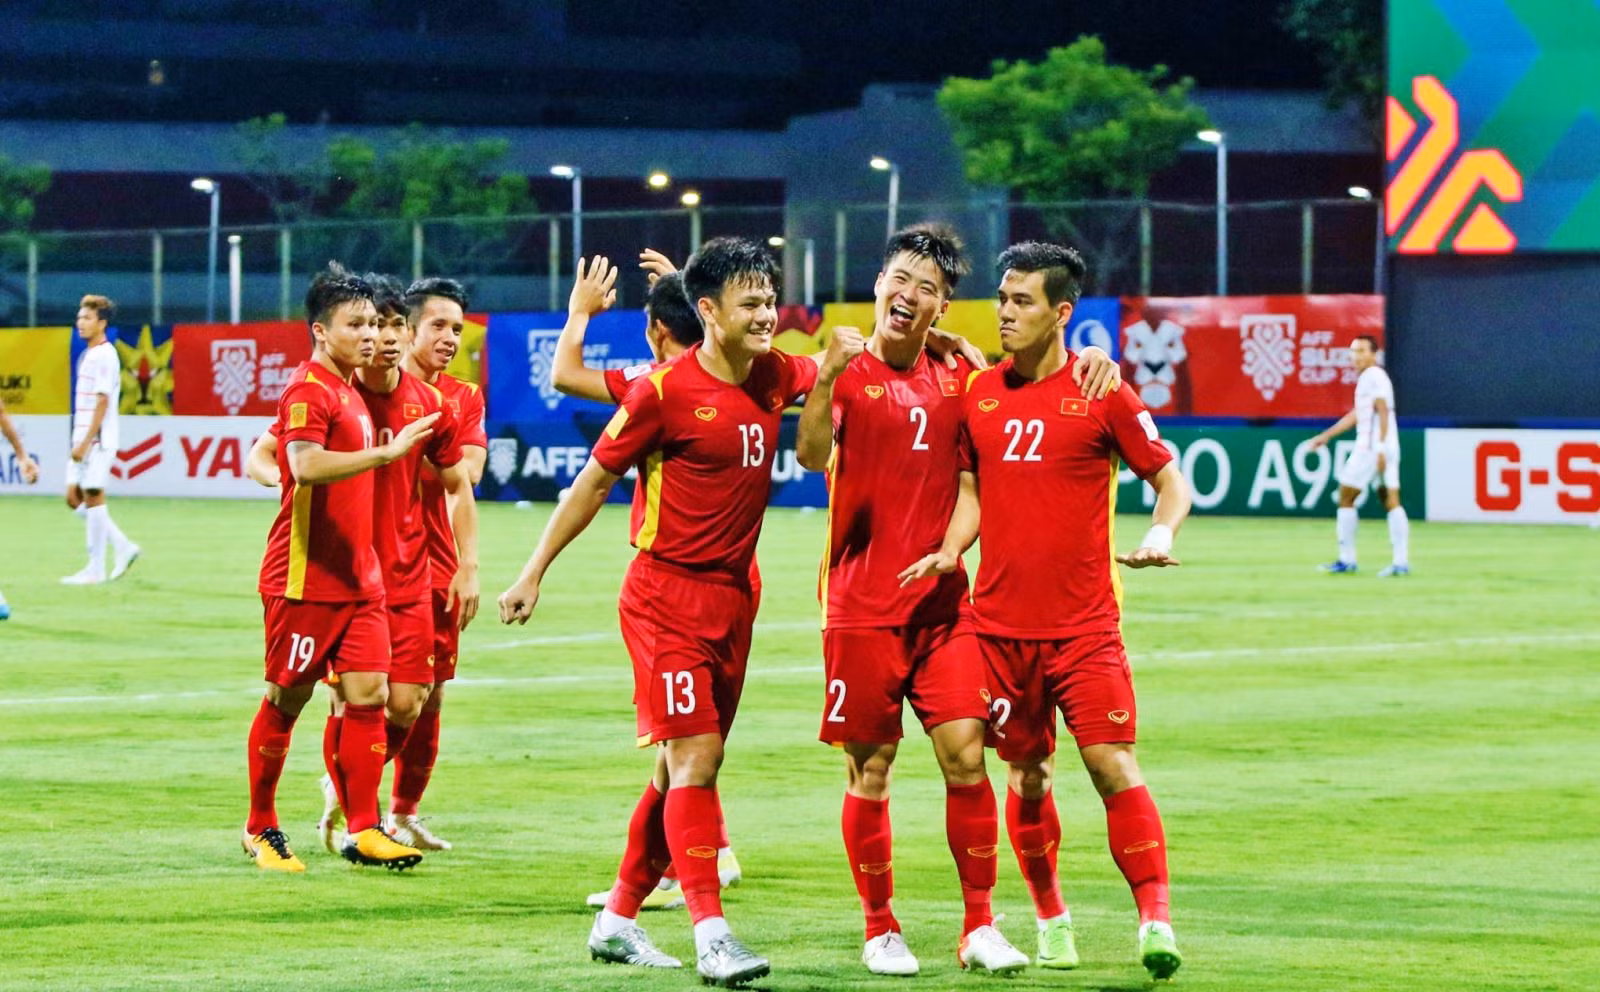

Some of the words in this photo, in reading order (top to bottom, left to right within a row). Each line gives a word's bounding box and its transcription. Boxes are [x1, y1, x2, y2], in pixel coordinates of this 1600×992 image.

[1301, 330, 1334, 345] AFF
[1300, 368, 1336, 384] CUP
[738, 423, 765, 467] 13
[910, 406, 929, 450] 2
[1003, 418, 1045, 461] 22
[522, 447, 588, 478] AFF
[287, 633, 315, 673] 19
[662, 670, 696, 716] 13
[827, 678, 847, 723] 2
[990, 697, 1011, 740] 2
